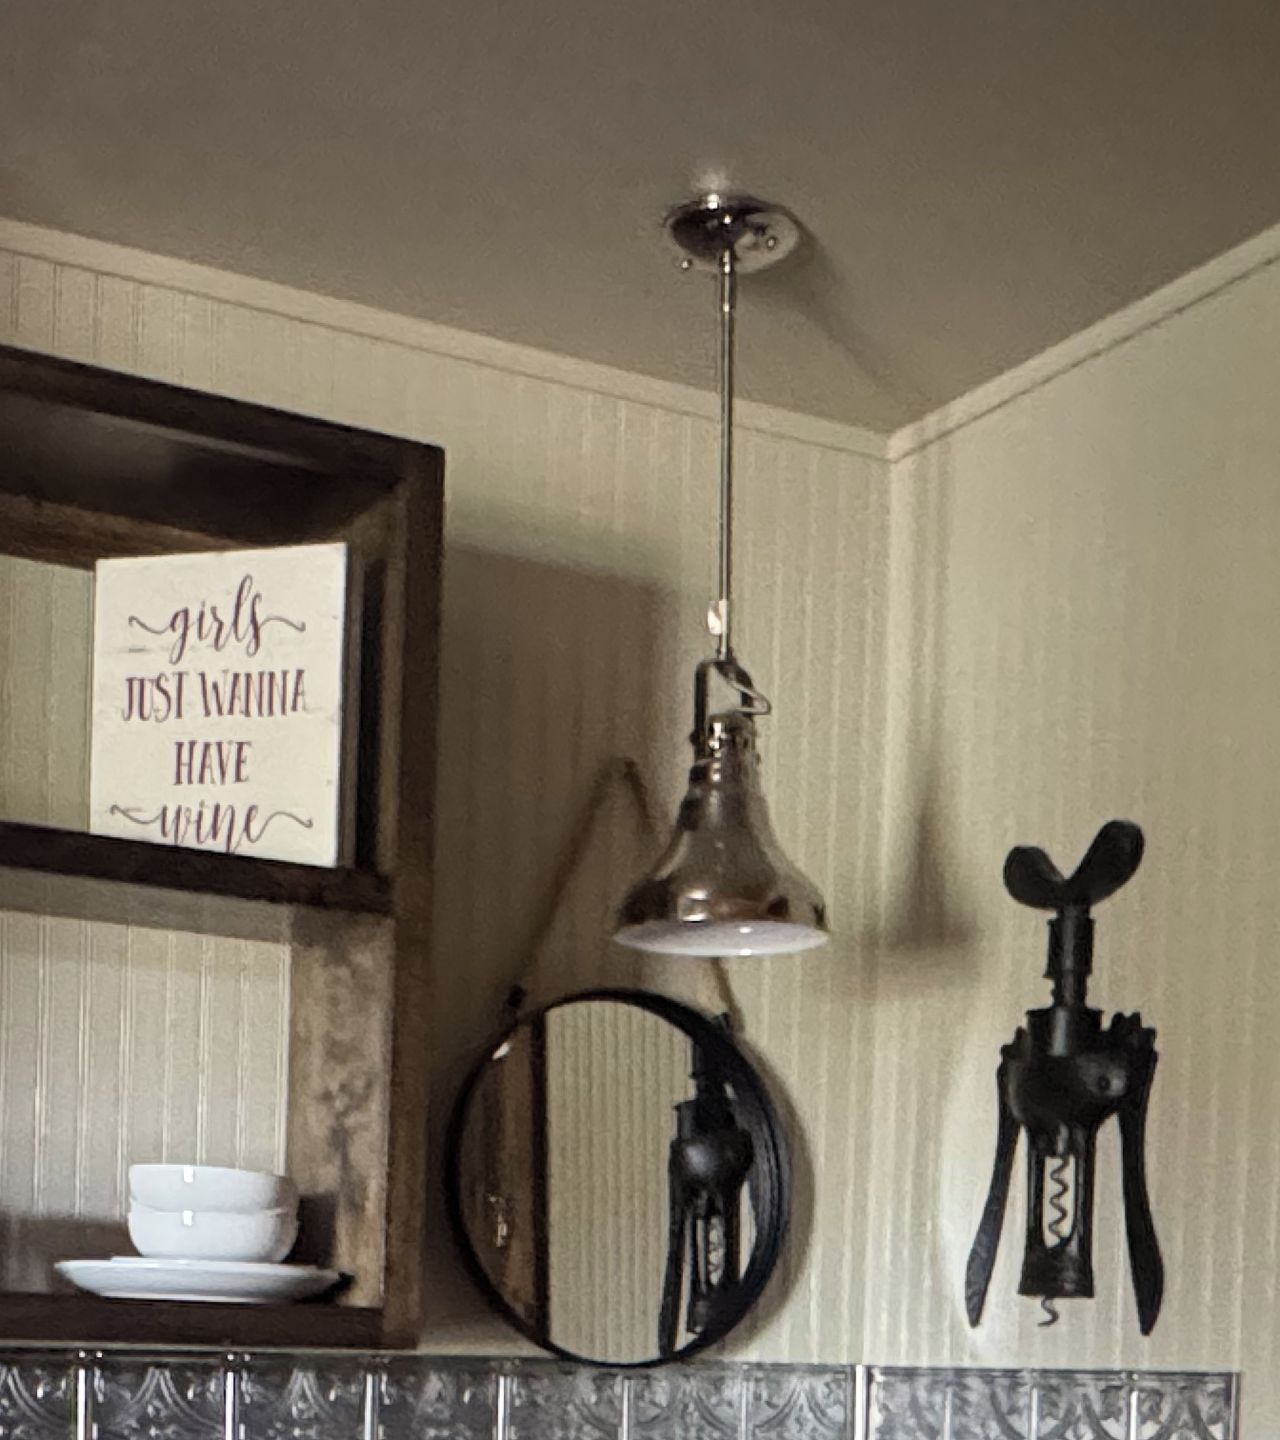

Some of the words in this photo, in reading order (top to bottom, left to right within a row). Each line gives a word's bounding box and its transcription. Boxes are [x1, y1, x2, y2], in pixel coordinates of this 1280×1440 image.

[128, 573, 306, 665] girls
[122, 671, 189, 722] JUST
[199, 668, 307, 718] WANNA
[173, 740, 252, 786] HAVE
[110, 800, 312, 854] wine
